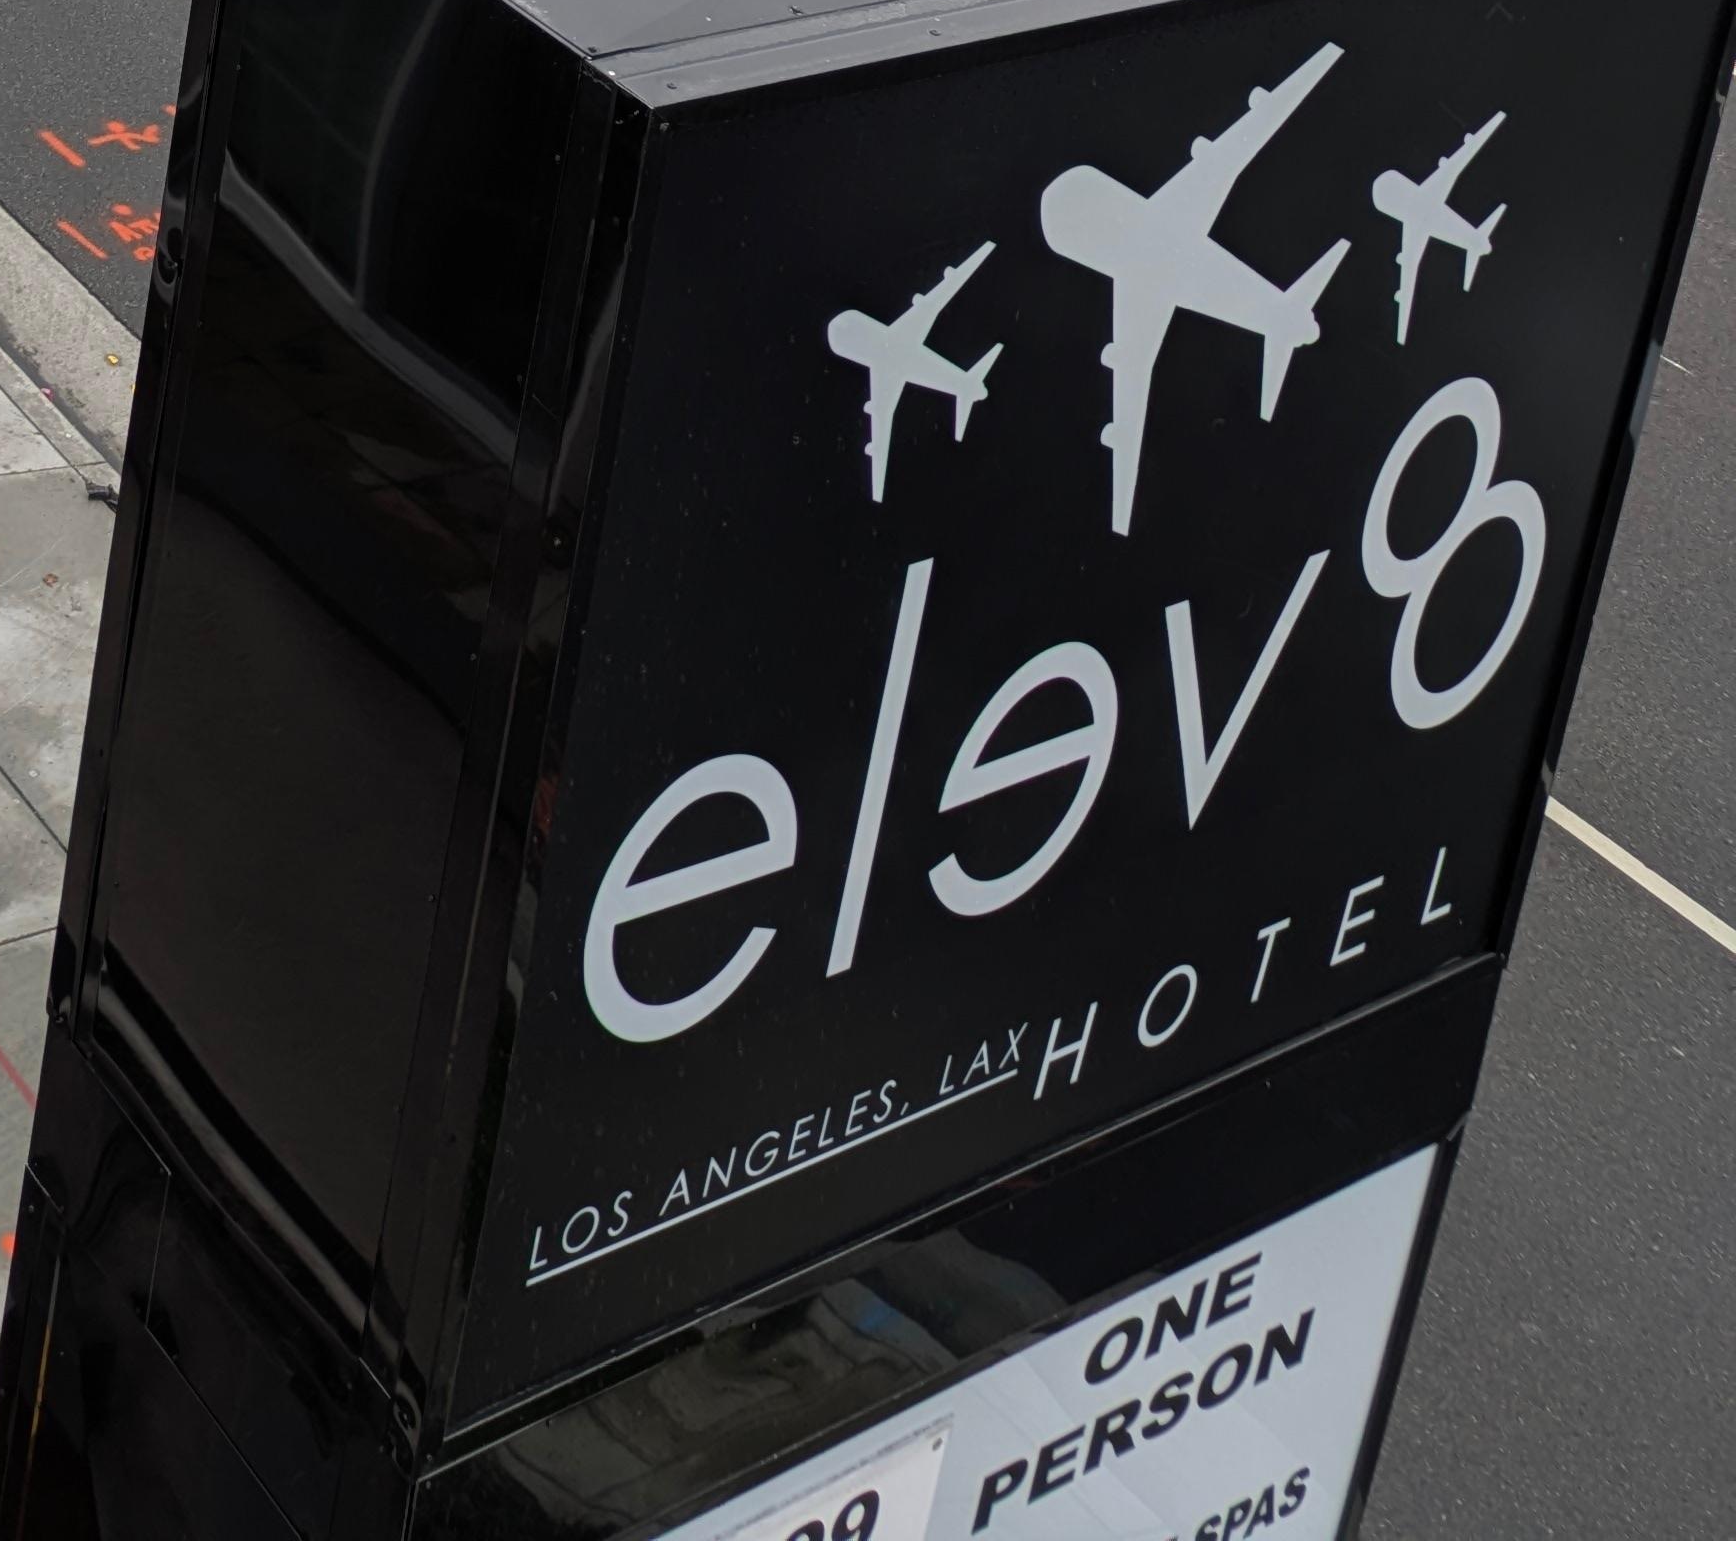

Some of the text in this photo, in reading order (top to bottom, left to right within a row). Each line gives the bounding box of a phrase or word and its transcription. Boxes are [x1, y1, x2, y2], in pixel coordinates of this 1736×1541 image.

[581, 376, 1546, 1044] elev8
[1032, 846, 1453, 1102] HOTEL
[528, 1021, 1029, 1272] LOS ANGELES, LAX
[971, 1309, 1317, 1536] PERSON
[1082, 1253, 1263, 1387] ONE
